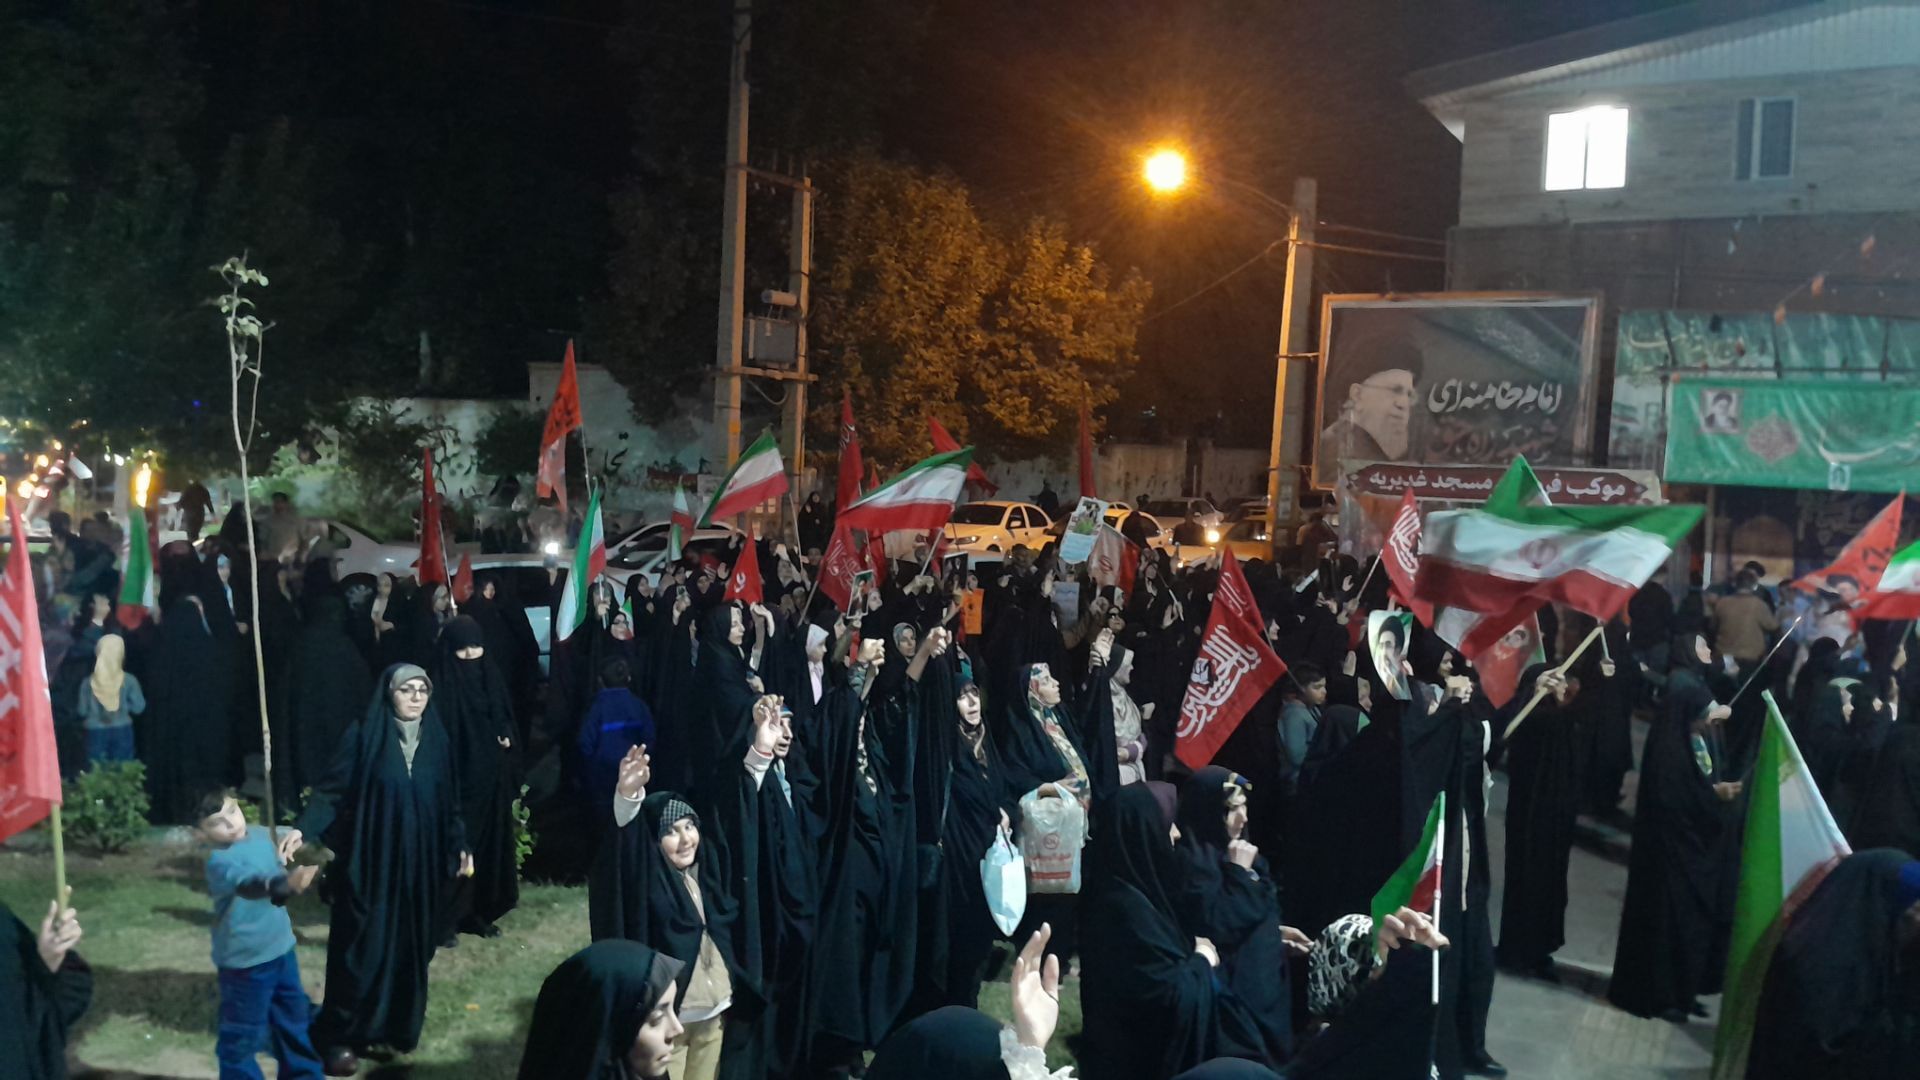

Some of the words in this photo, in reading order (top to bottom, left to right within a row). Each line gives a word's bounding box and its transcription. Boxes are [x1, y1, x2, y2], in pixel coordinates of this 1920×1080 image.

[1369, 469, 1428, 490] غدیریه
[1431, 475, 1493, 491] مسجد
[1566, 476, 1626, 502] موکب
